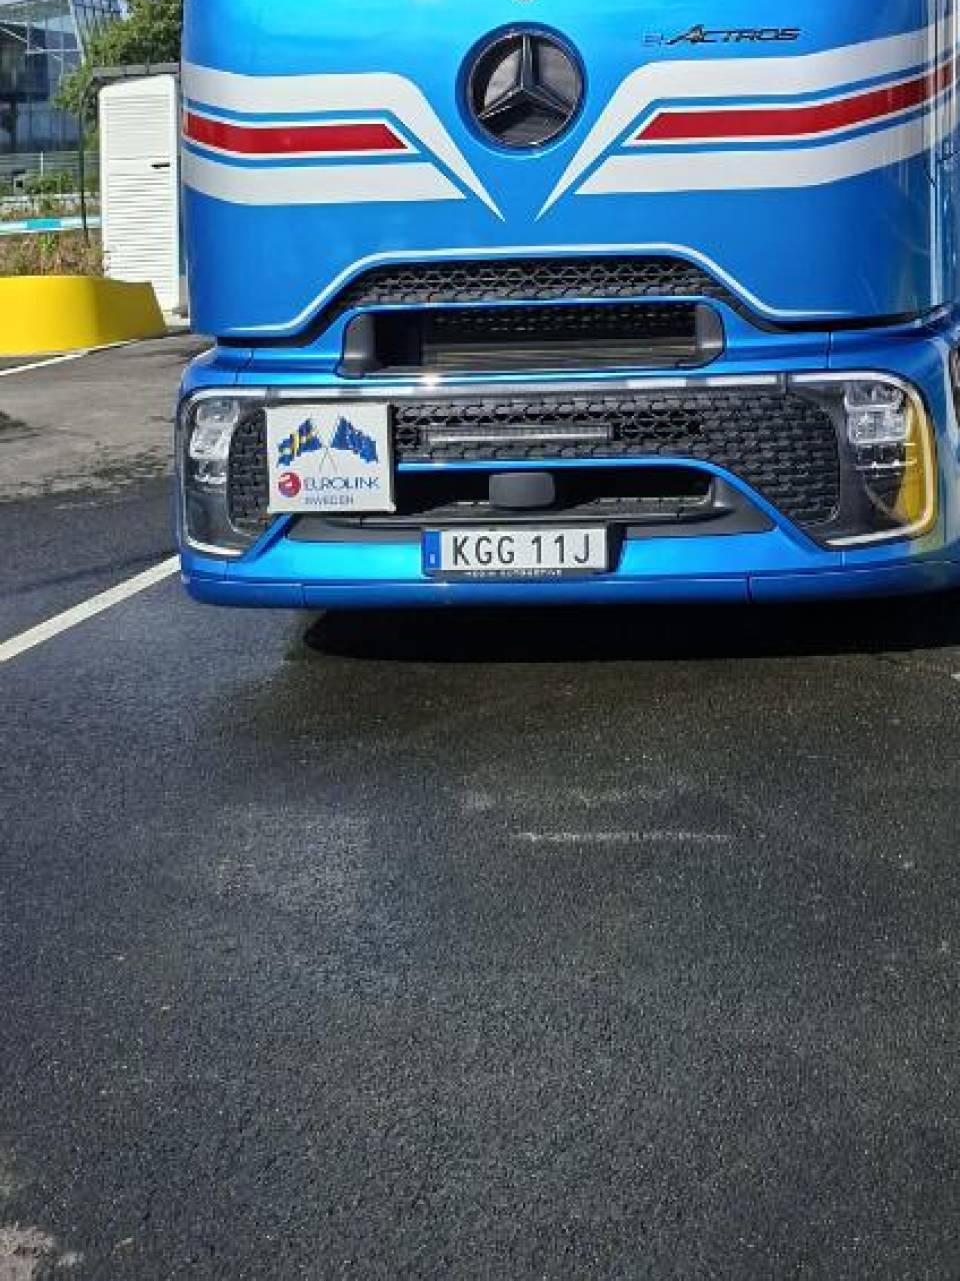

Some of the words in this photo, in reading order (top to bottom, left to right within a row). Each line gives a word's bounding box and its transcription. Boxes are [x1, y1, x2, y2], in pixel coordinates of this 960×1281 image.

[304, 476, 379, 491] EUROLINK
[452, 535, 515, 566] KGG
[531, 534, 590, 565] 11J
